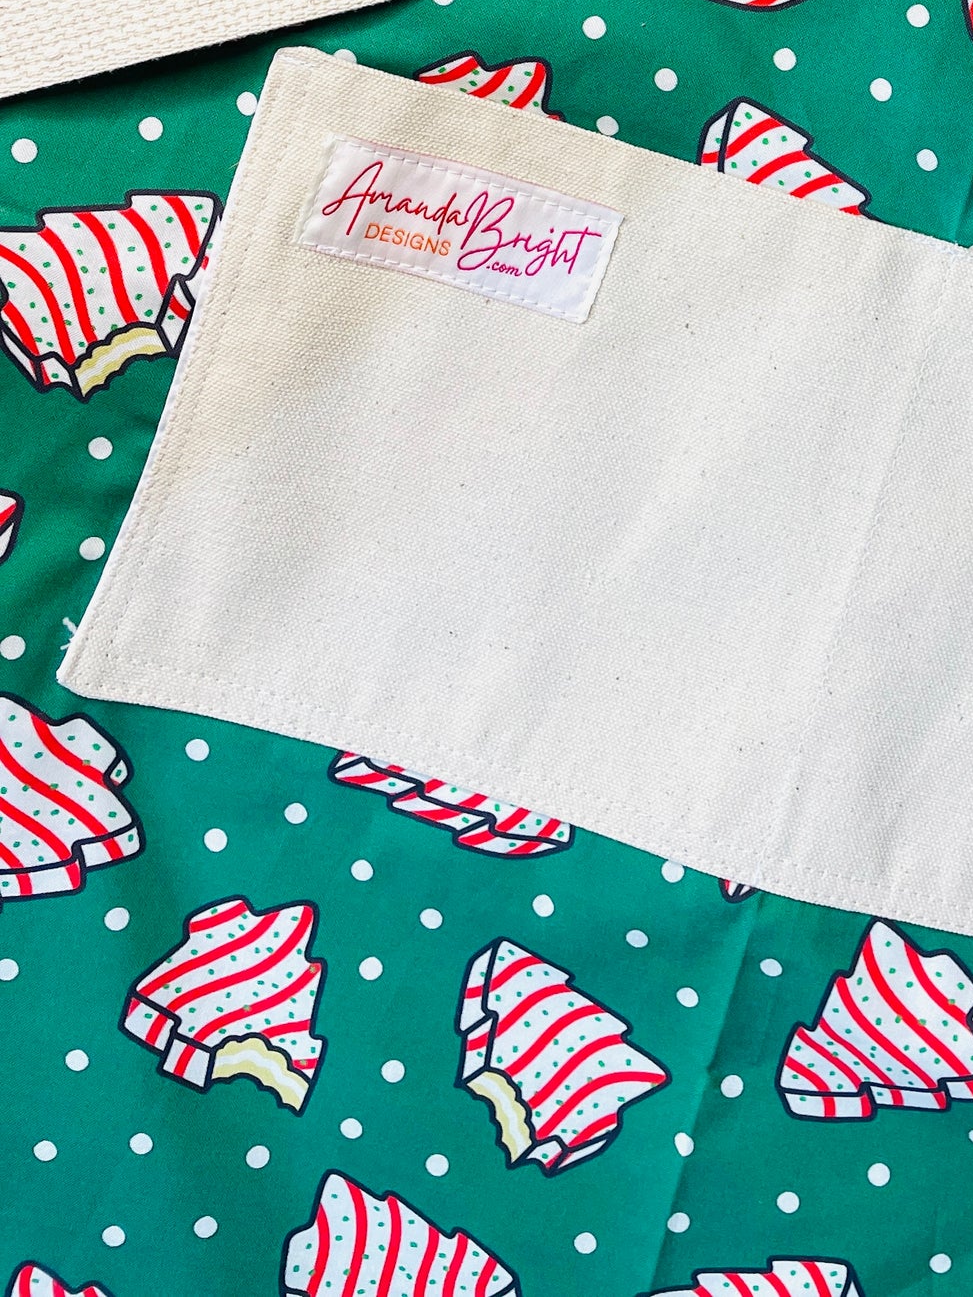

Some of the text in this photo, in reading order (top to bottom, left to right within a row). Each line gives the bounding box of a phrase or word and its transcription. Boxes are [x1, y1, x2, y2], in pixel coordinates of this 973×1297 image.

[321, 160, 602, 277] Amanda Bright
[363, 222, 452, 256] DESIGNS
[485, 260, 524, 277] .com
